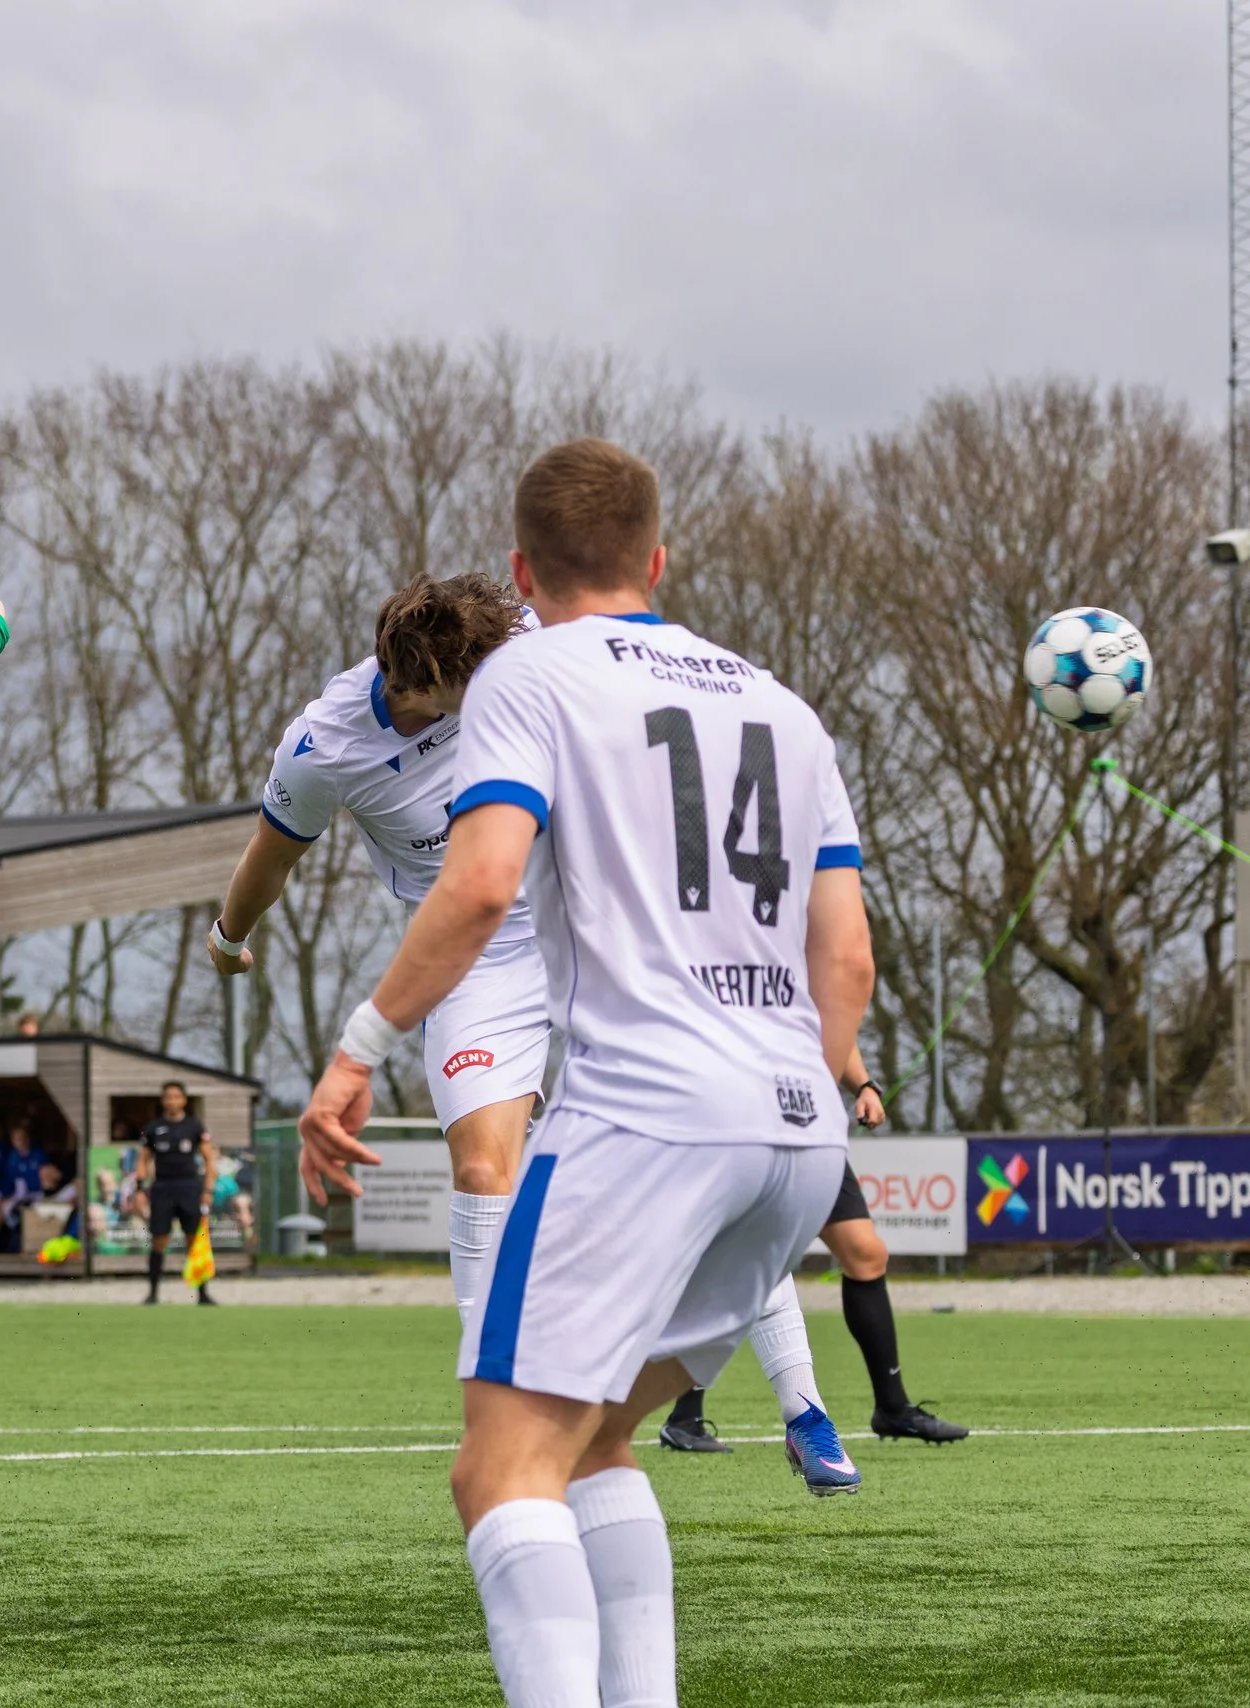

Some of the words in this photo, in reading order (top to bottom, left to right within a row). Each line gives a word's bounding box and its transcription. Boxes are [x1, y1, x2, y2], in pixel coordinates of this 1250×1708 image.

[651, 666, 743, 694] CATERING
[417, 736, 437, 756] PK
[644, 706, 790, 928] 14
[447, 1053, 489, 1073] MENY
[857, 1173, 956, 1211] DEVO
[1056, 1162, 1166, 1209] Norsk
[1170, 1160, 1250, 1218] Tipp
